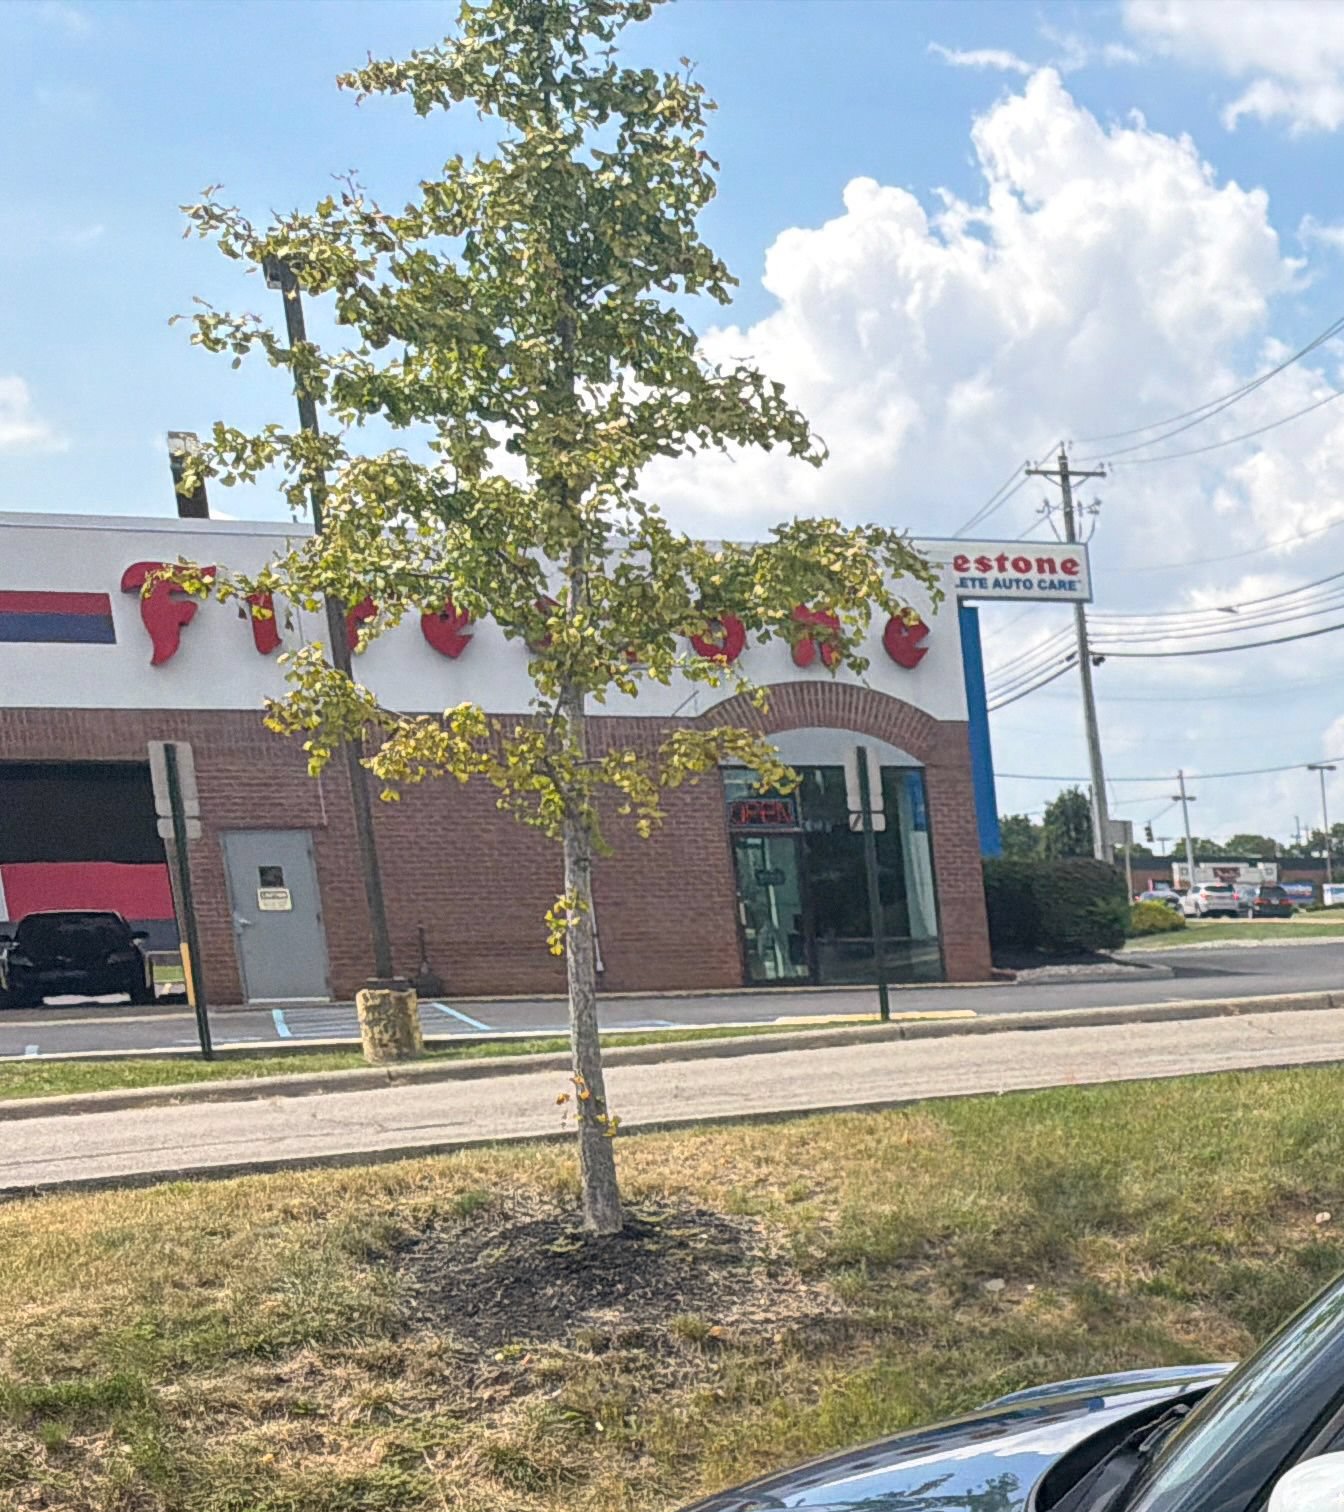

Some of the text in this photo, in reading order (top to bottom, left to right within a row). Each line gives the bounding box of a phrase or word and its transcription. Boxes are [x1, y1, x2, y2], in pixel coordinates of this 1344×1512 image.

[953, 552, 1080, 576] estone
[992, 578, 1033, 590] AUTO
[1037, 580, 1077, 592] CARE
